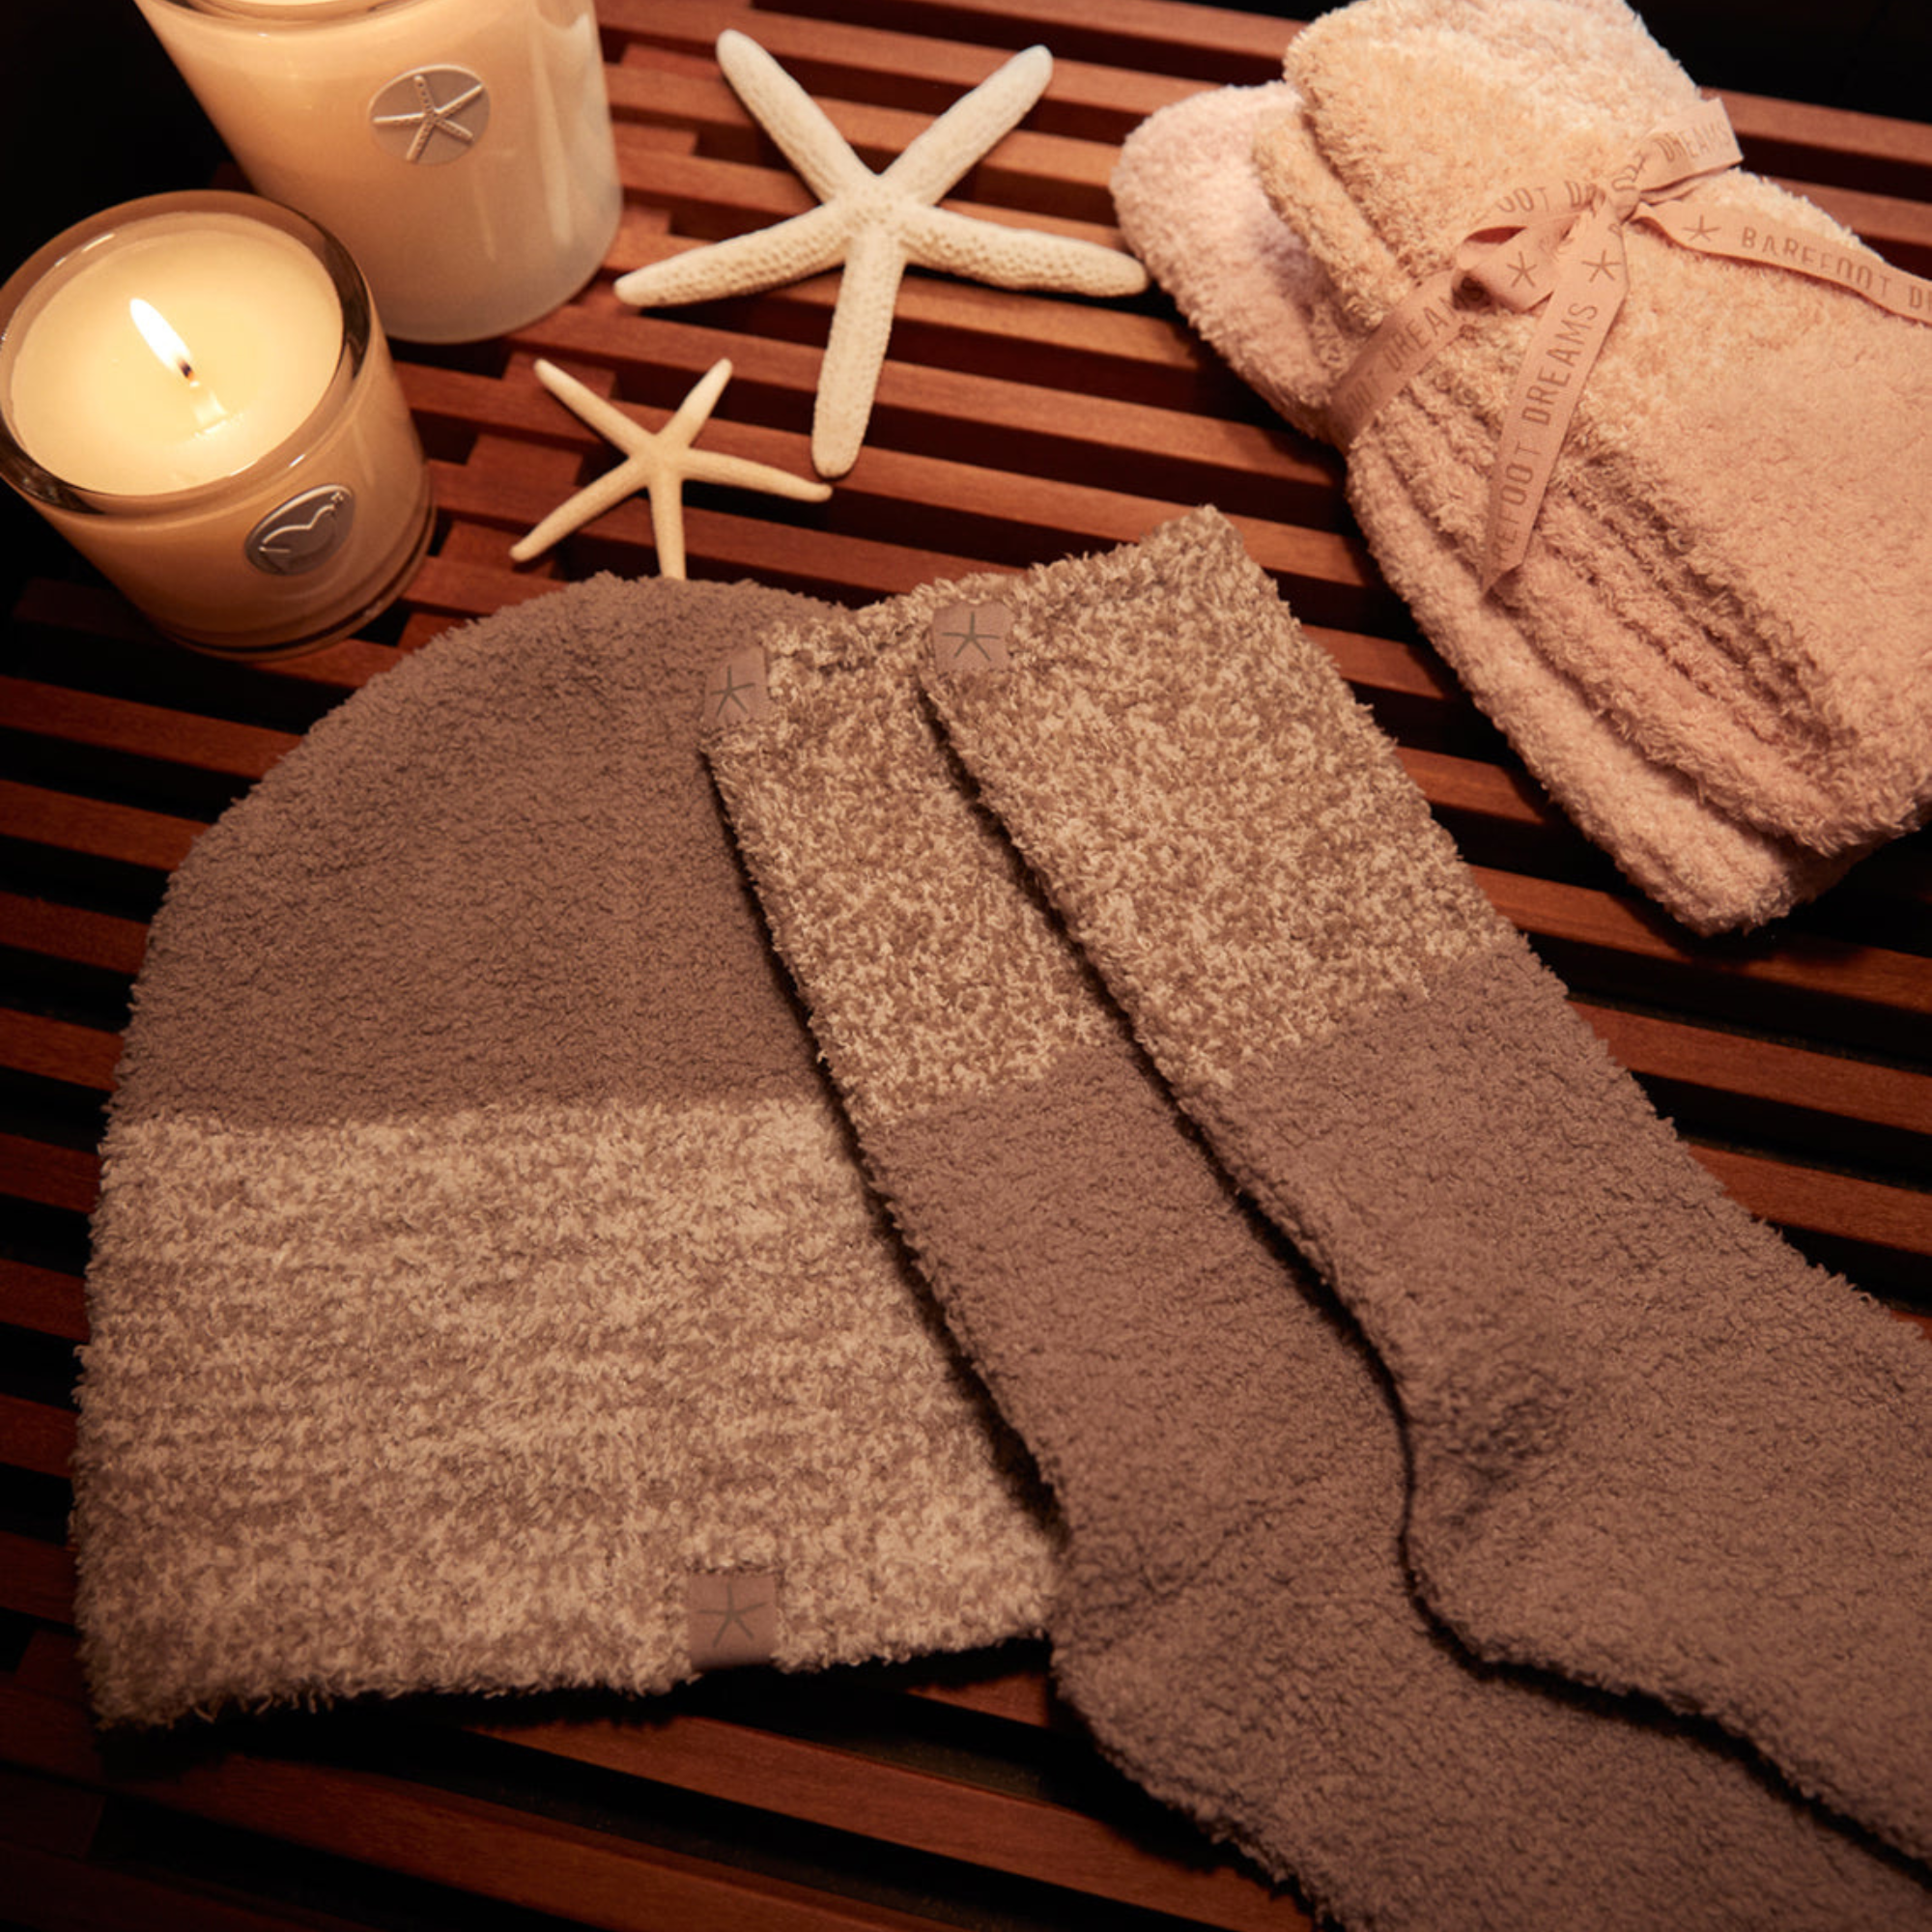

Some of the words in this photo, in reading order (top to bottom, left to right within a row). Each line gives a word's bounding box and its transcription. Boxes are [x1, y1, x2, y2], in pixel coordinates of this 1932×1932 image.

[1741, 226, 1892, 299] BAREFOOT
[1491, 440, 1543, 563] REFOOT
[1520, 302, 1599, 427] DREAMS
